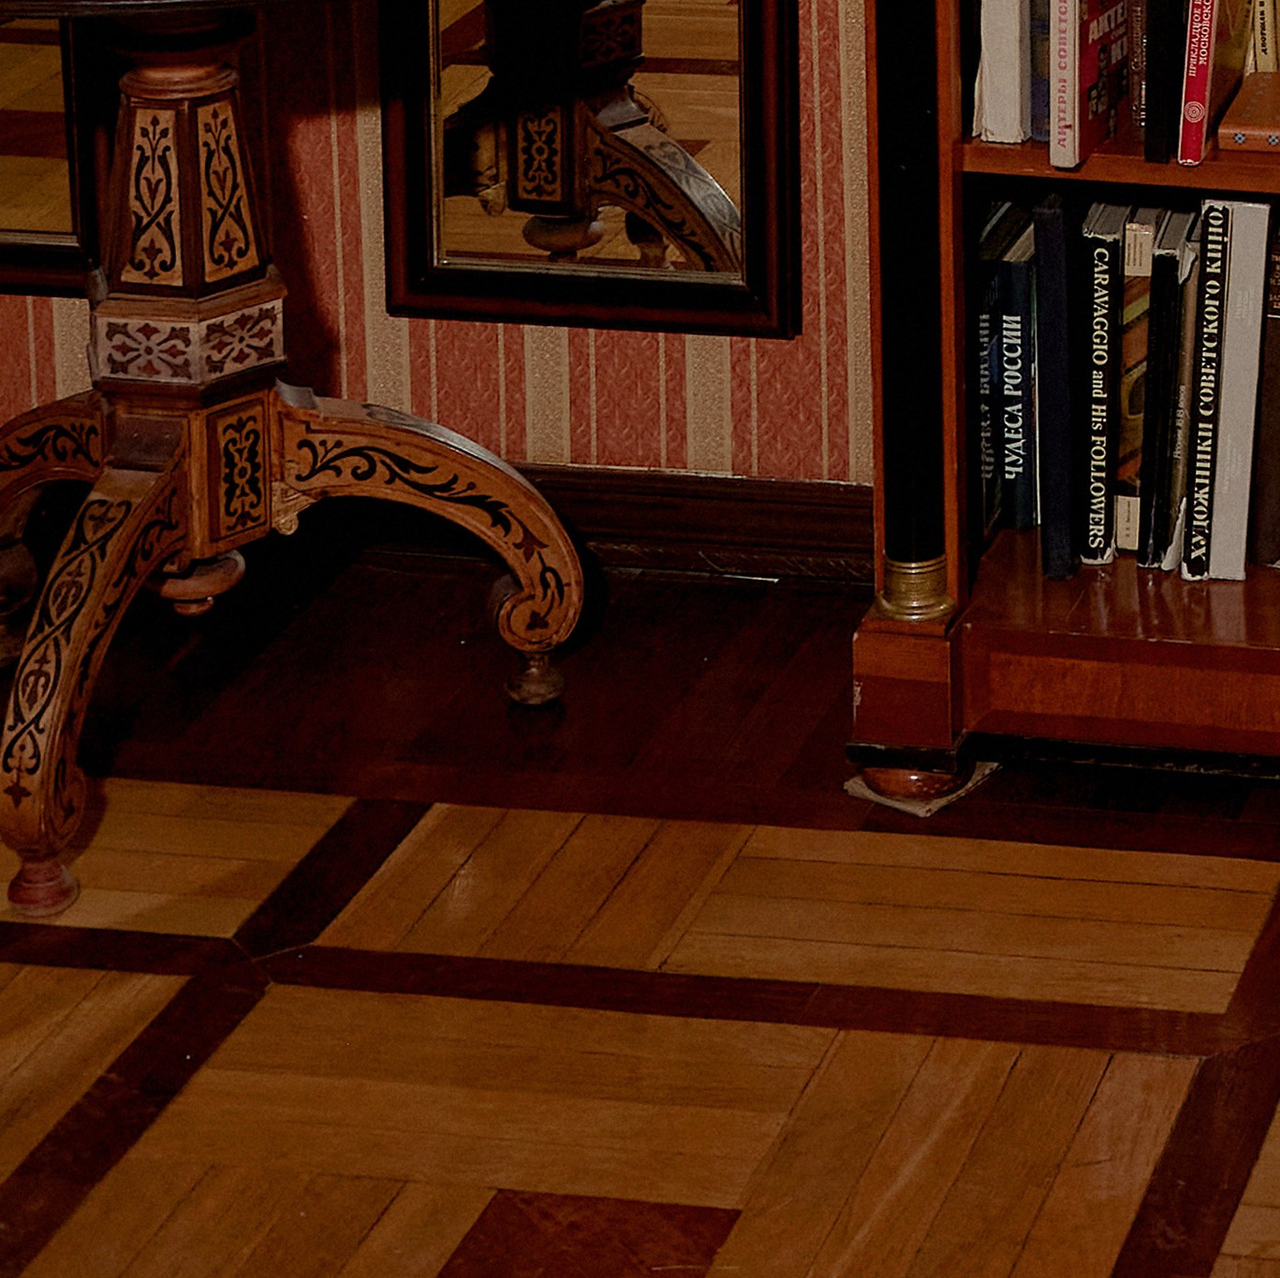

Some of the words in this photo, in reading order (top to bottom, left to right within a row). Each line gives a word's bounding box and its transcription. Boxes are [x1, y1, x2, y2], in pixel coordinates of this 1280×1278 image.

[1188, 5, 1203, 77] ПРИКЛАДНОЕ
[1203, 207, 1228, 276] КИНО
[1091, 246, 1110, 367] CARAVAGGIO
[1002, 314, 1023, 397] РОССИИ
[1091, 369, 1108, 399] and
[1197, 279, 1222, 419] СОВЕТСКОГО
[1003, 403, 1025, 481] ЧУДЕСА
[1091, 404, 1108, 431] His
[1087, 435, 1107, 551] FOLLOWERS
[1189, 422, 1213, 562] ХУДОЖНИКИ
